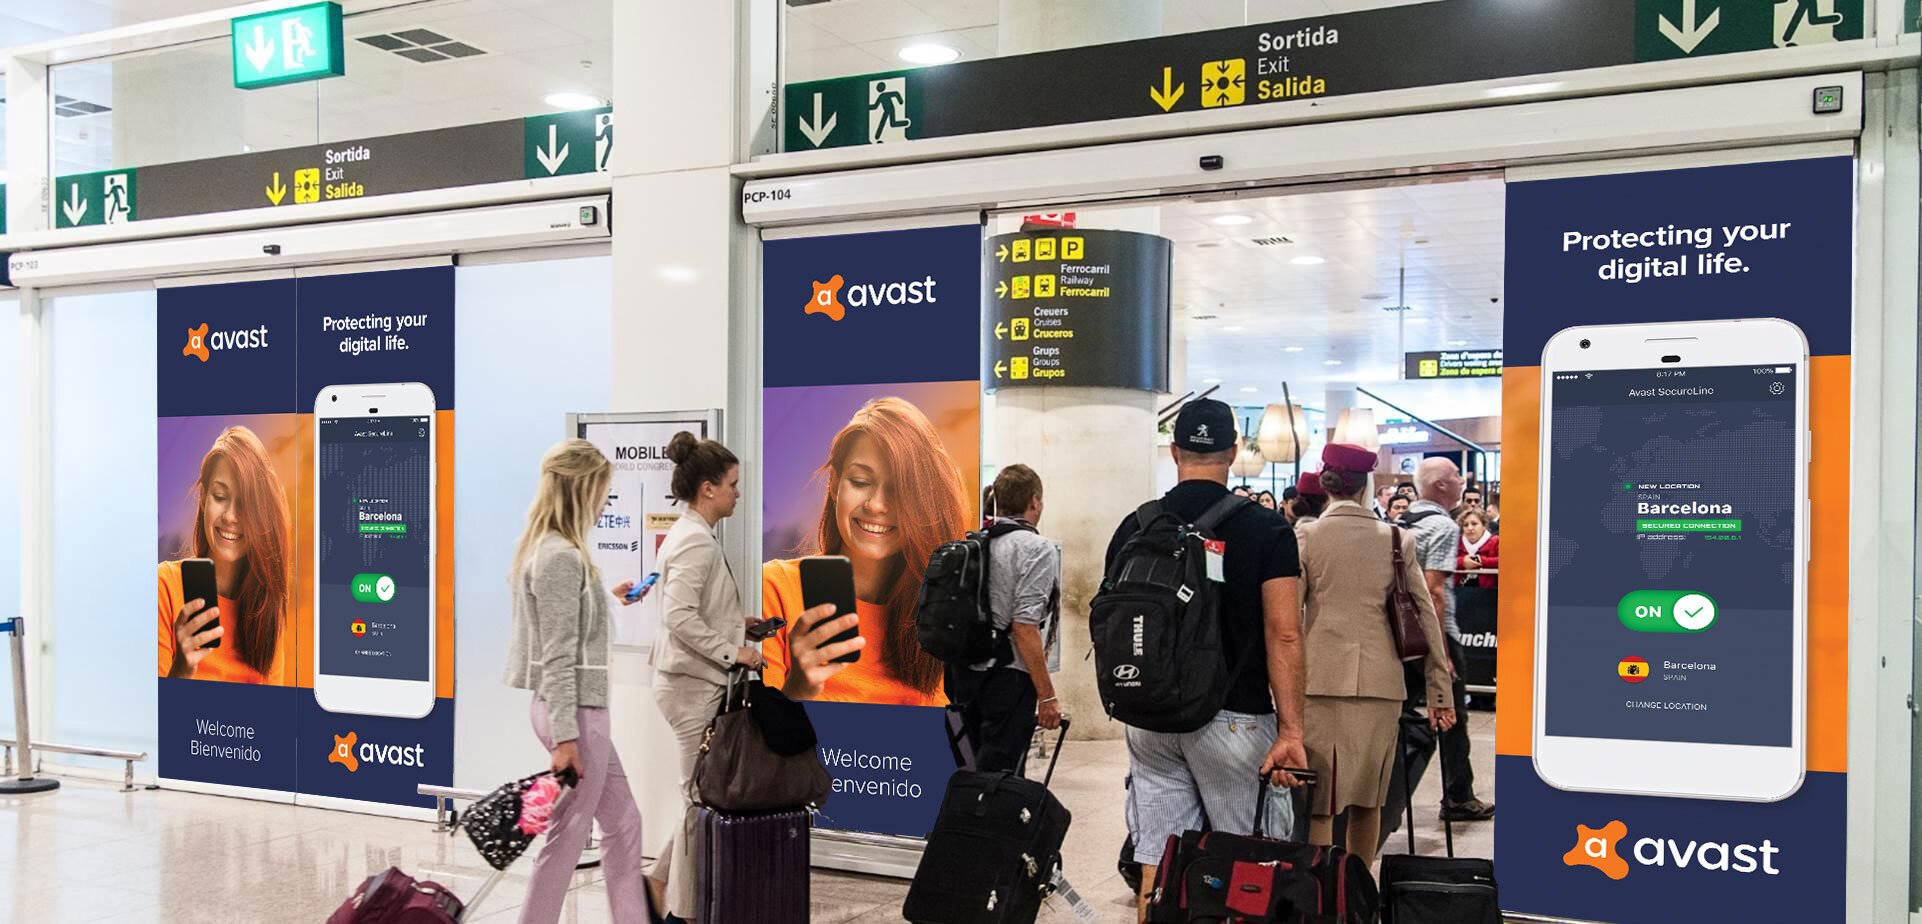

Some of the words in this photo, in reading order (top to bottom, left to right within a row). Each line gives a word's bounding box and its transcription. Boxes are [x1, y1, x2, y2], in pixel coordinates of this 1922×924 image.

[1258, 26, 1338, 52] Sortida
[1258, 56, 1290, 75] Exit
[1258, 75, 1325, 100] Salida
[325, 145, 370, 164] Sortida
[325, 167, 345, 180] Exit
[325, 182, 364, 199] Salida
[744, 188, 792, 203] PCP-104
[1563, 224, 1713, 251] Protecting
[1722, 222, 1792, 248] your
[1060, 264, 1110, 274] Ferrocarril
[1598, 255, 1687, 284] digital
[1698, 252, 1750, 275] life.
[1060, 275, 1094, 285] Railway
[847, 275, 937, 307] avast
[1060, 287, 1110, 297] Ferrocarril
[1033, 307, 1069, 316] Creuers
[323, 313, 392, 332] Protecting
[396, 313, 428, 331] your
[1033, 317, 1062, 326] Cruises
[210, 324, 269, 350] avast
[1033, 328, 1074, 338] Cruceros
[339, 335, 381, 356] digital
[385, 334, 410, 351] life.
[1032, 346, 1060, 356] Grups
[1032, 356, 1060, 367] Groups
[1032, 368, 1065, 379] Grupos
[1753, 366, 1774, 374] 100%
[1628, 387, 1656, 397] Avast
[1658, 386, 1714, 396] SecureLine
[616, 446, 671, 460] MOBILE
[614, 463, 635, 471] ORLD
[1637, 501, 1733, 514] Barcelona
[359, 511, 403, 521] Barcelona
[598, 542, 629, 551] ERICSSON
[358, 583, 371, 593] ON
[1635, 605, 1662, 618] ON
[1133, 615, 1144, 656] THULE
[1663, 661, 1716, 671] Barcelona
[1626, 700, 1661, 709] CHANGE
[1664, 702, 1707, 711] LOCATION
[196, 718, 255, 740] Welcome
[190, 739, 261, 762] Bienvenido
[359, 742, 425, 768] avast
[821, 747, 912, 772] Welcome
[831, 777, 922, 798] envenido
[1633, 837, 1780, 875] avast
